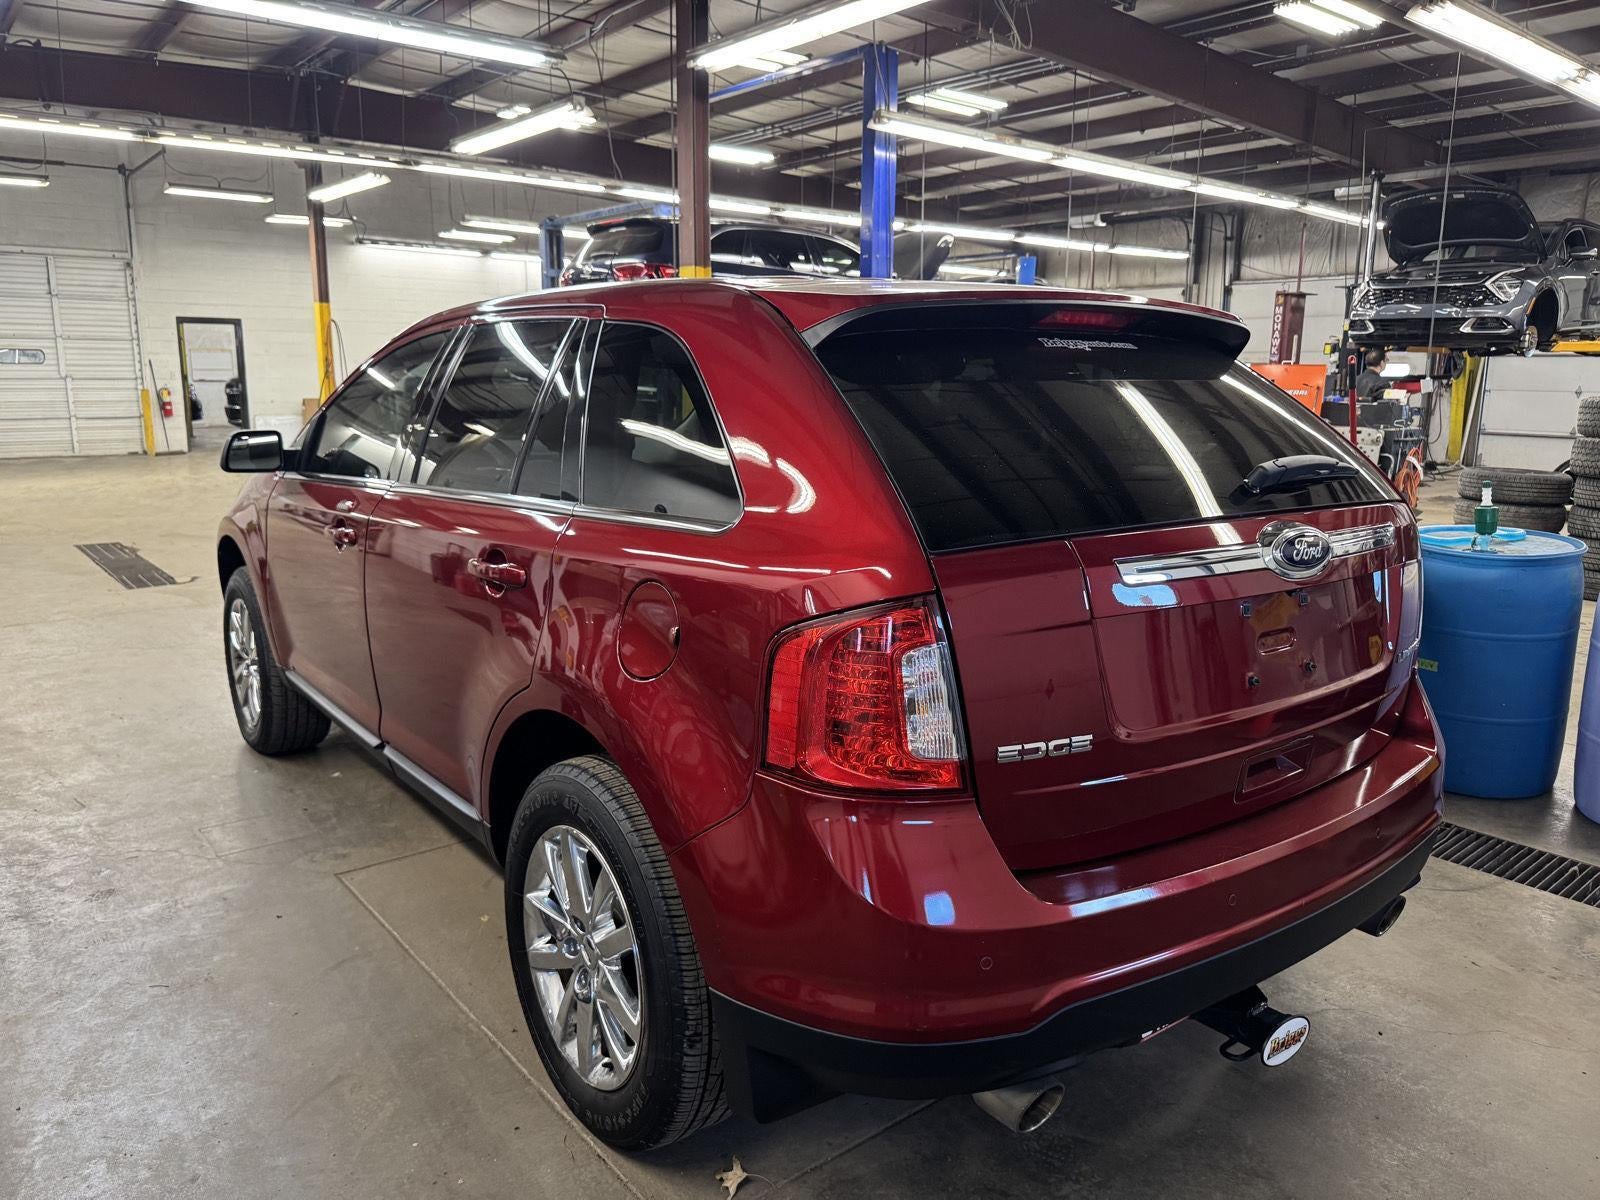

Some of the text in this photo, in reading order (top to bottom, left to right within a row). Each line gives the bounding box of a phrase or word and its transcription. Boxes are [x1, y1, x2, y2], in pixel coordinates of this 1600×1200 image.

[1271, 306, 1283, 354] MOHAWK
[1293, 536, 1323, 561] Ford
[997, 734, 1093, 764] EDGE
